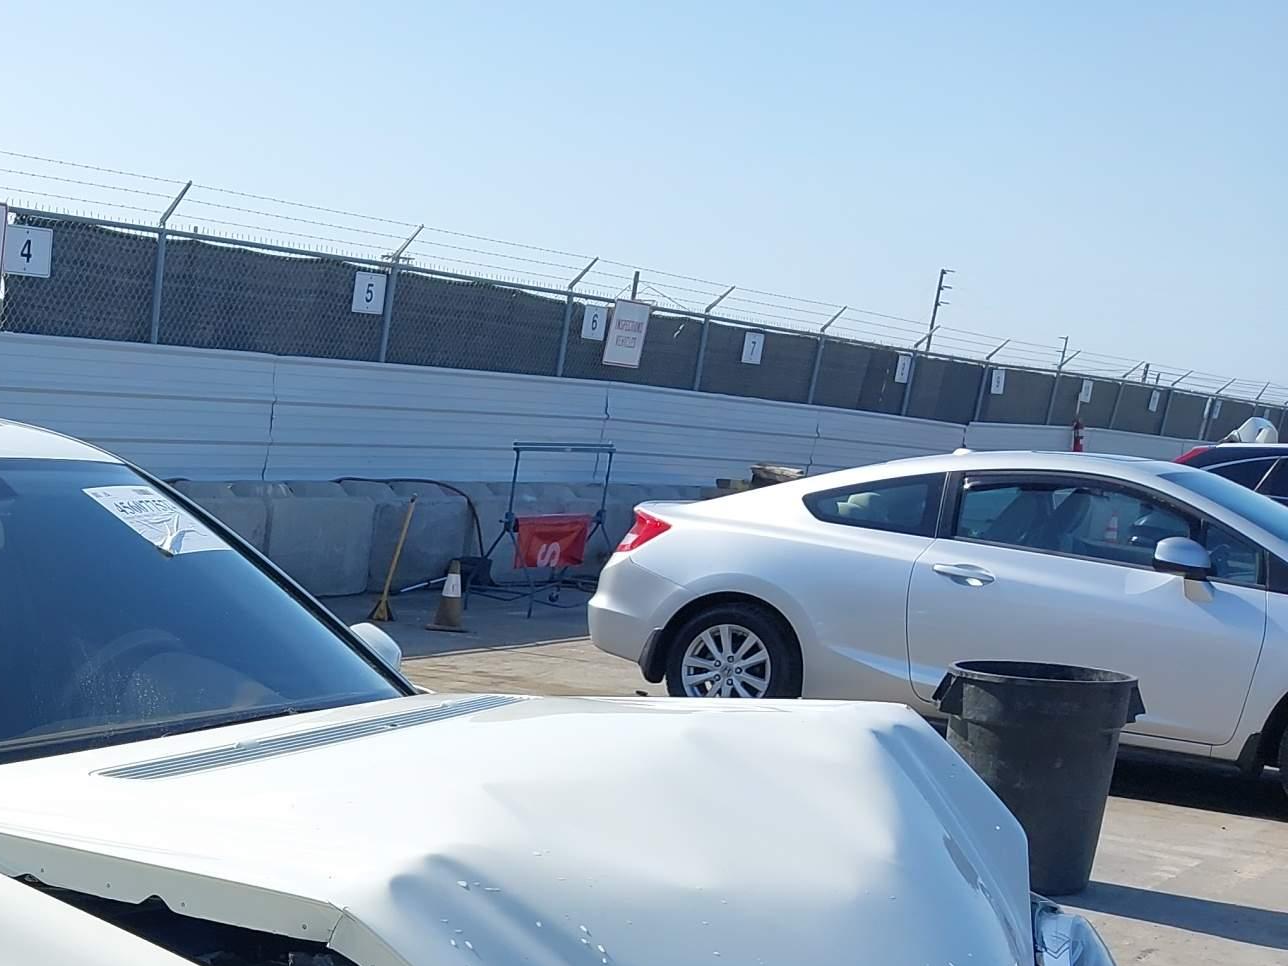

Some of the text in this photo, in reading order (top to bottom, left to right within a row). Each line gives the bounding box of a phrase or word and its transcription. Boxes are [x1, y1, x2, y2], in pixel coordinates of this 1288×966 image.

[20, 239, 33, 263] 4
[365, 283, 375, 303] 5
[591, 313, 599, 331] 6
[750, 341, 757, 356] 7
